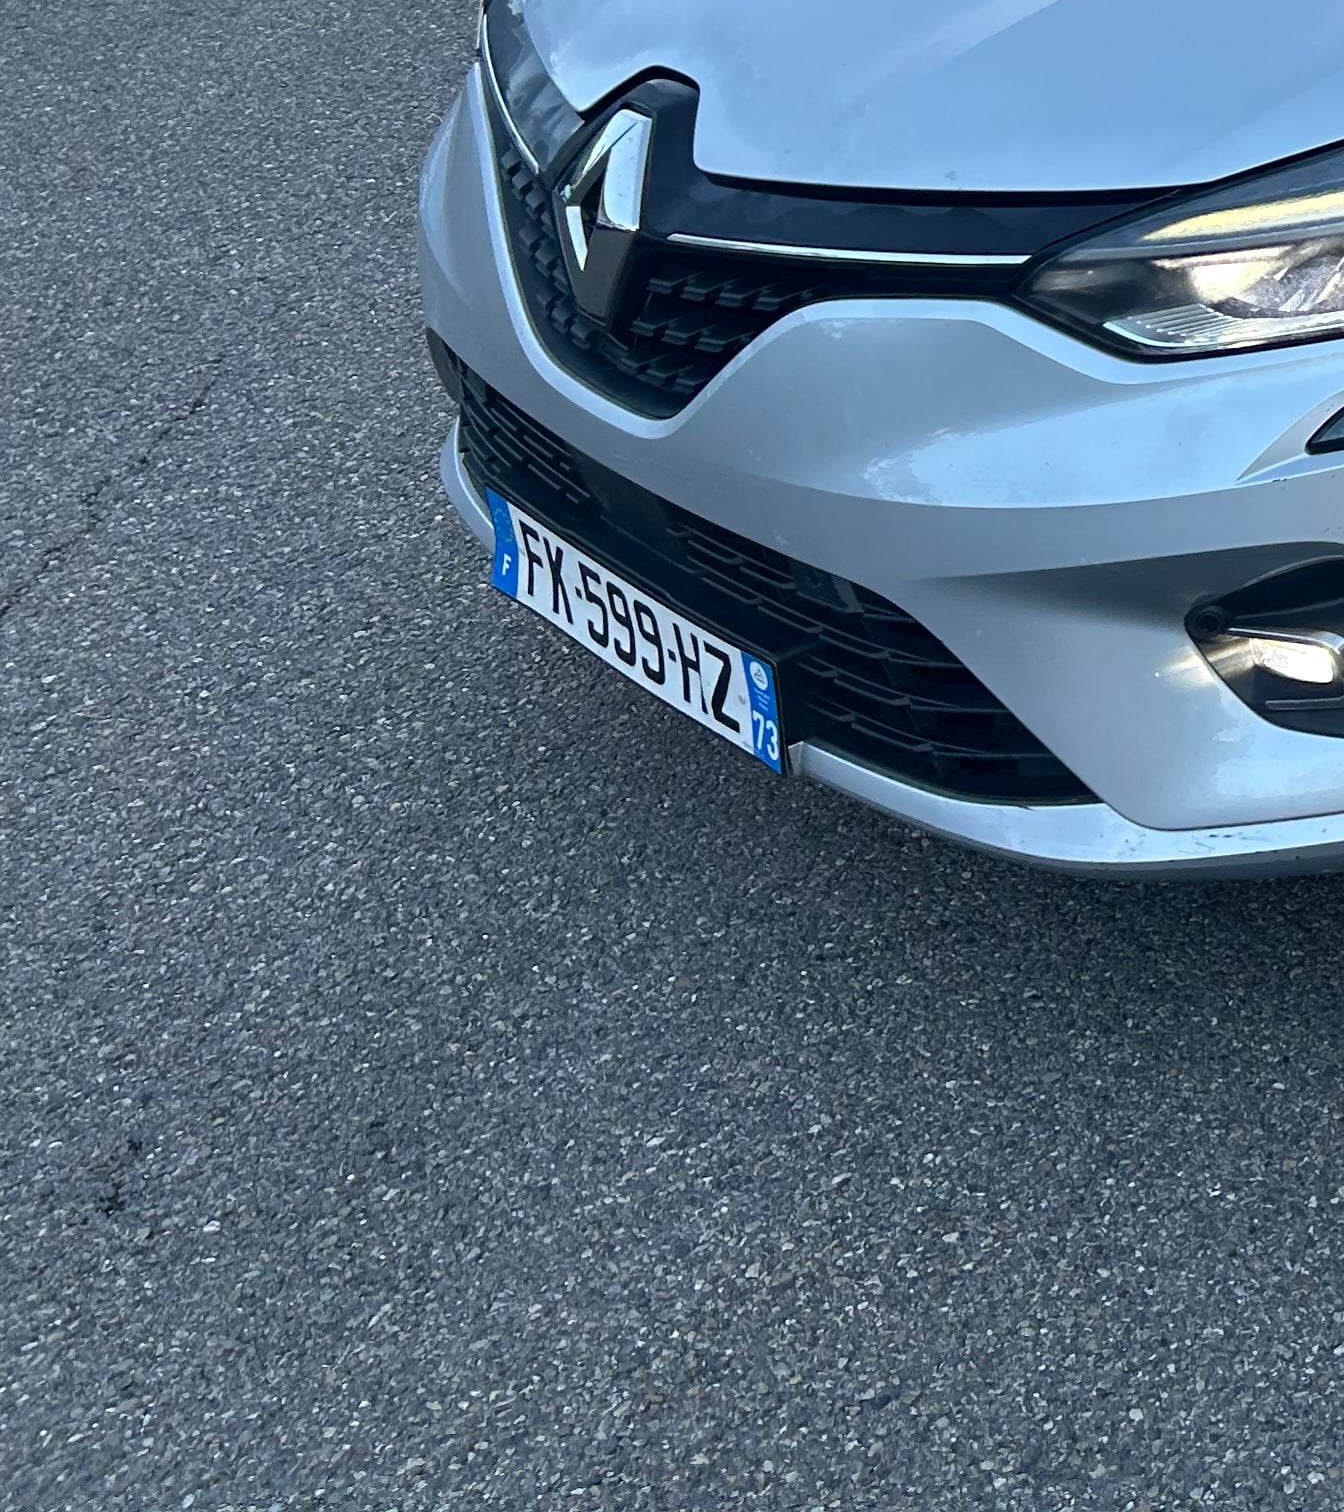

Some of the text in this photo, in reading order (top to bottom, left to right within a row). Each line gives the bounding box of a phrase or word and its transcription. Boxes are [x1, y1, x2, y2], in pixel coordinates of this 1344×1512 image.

[501, 553, 512, 576] F
[519, 519, 740, 733] FK-599-HZ
[752, 709, 779, 761] 73
